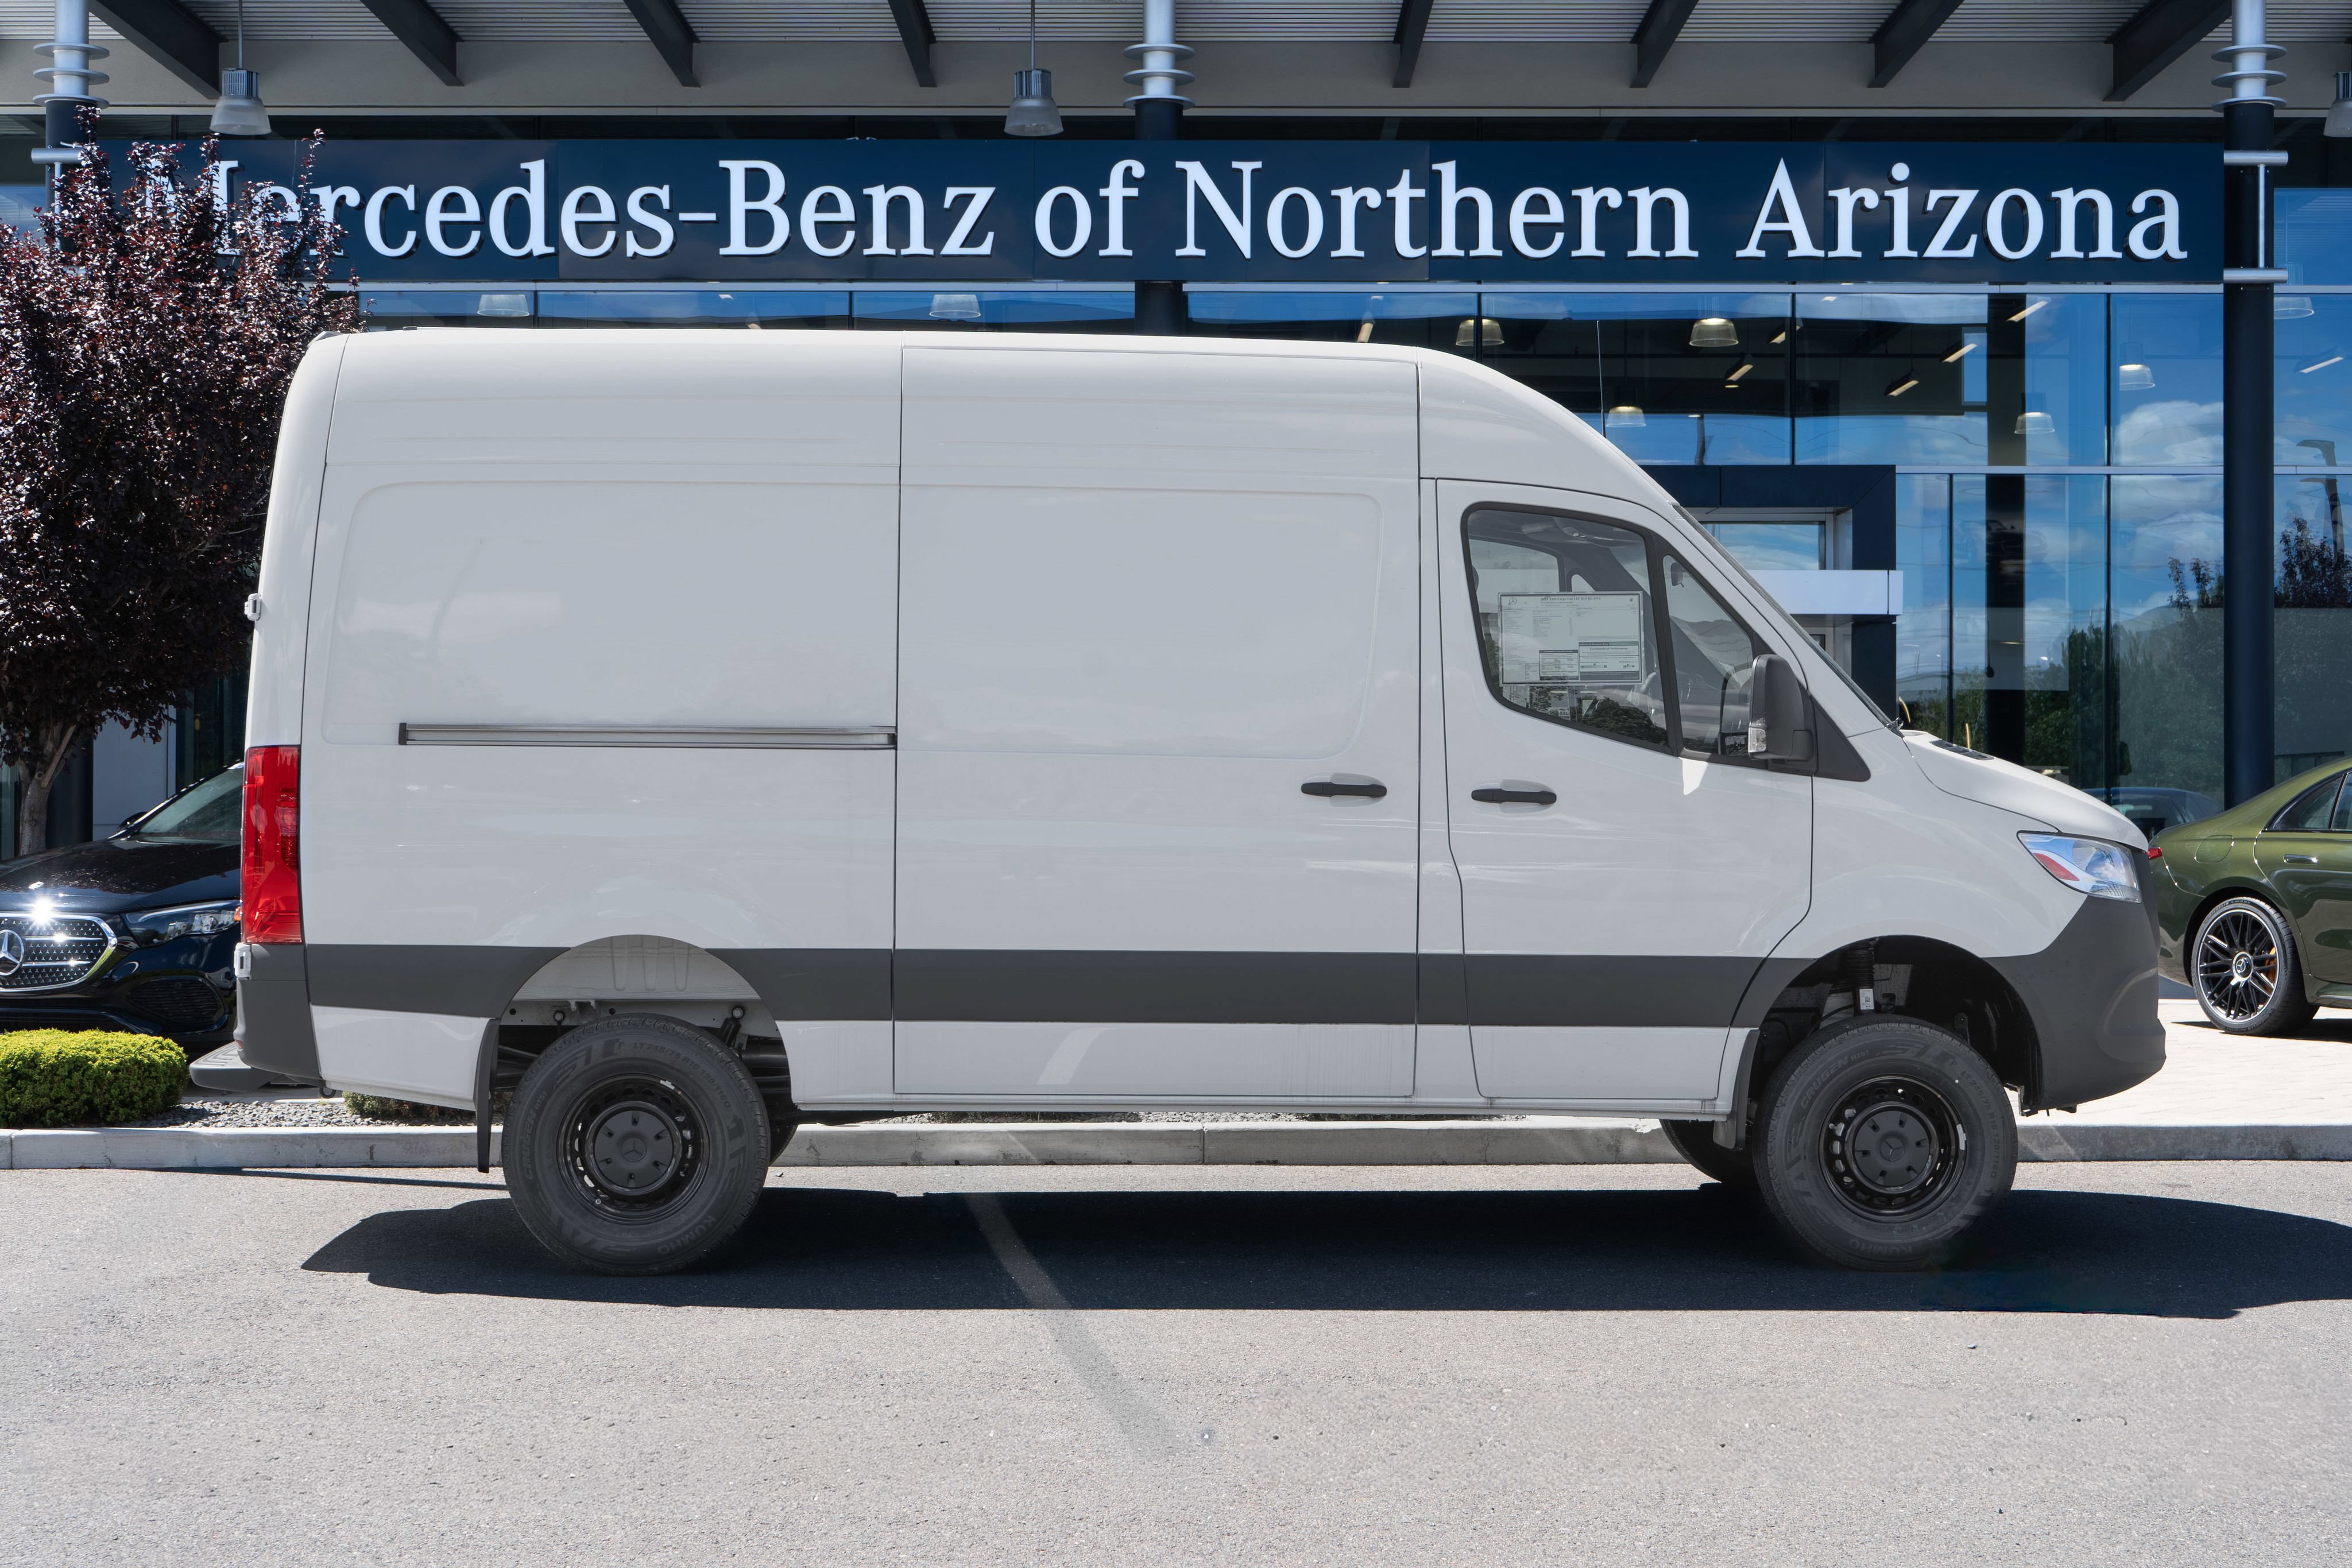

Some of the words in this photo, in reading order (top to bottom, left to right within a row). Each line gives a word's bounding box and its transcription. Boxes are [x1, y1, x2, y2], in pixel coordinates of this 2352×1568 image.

[1035, 160, 1144, 255] of
[1175, 161, 1697, 258] Northern
[1736, 162, 2178, 258] Arizona
[1800, 1055, 1849, 1110] CRUGEN
[522, 1108, 537, 1180] CRUGEN
[657, 1214, 717, 1255] KUMHO
[1848, 1239, 1913, 1256] KUMHO
